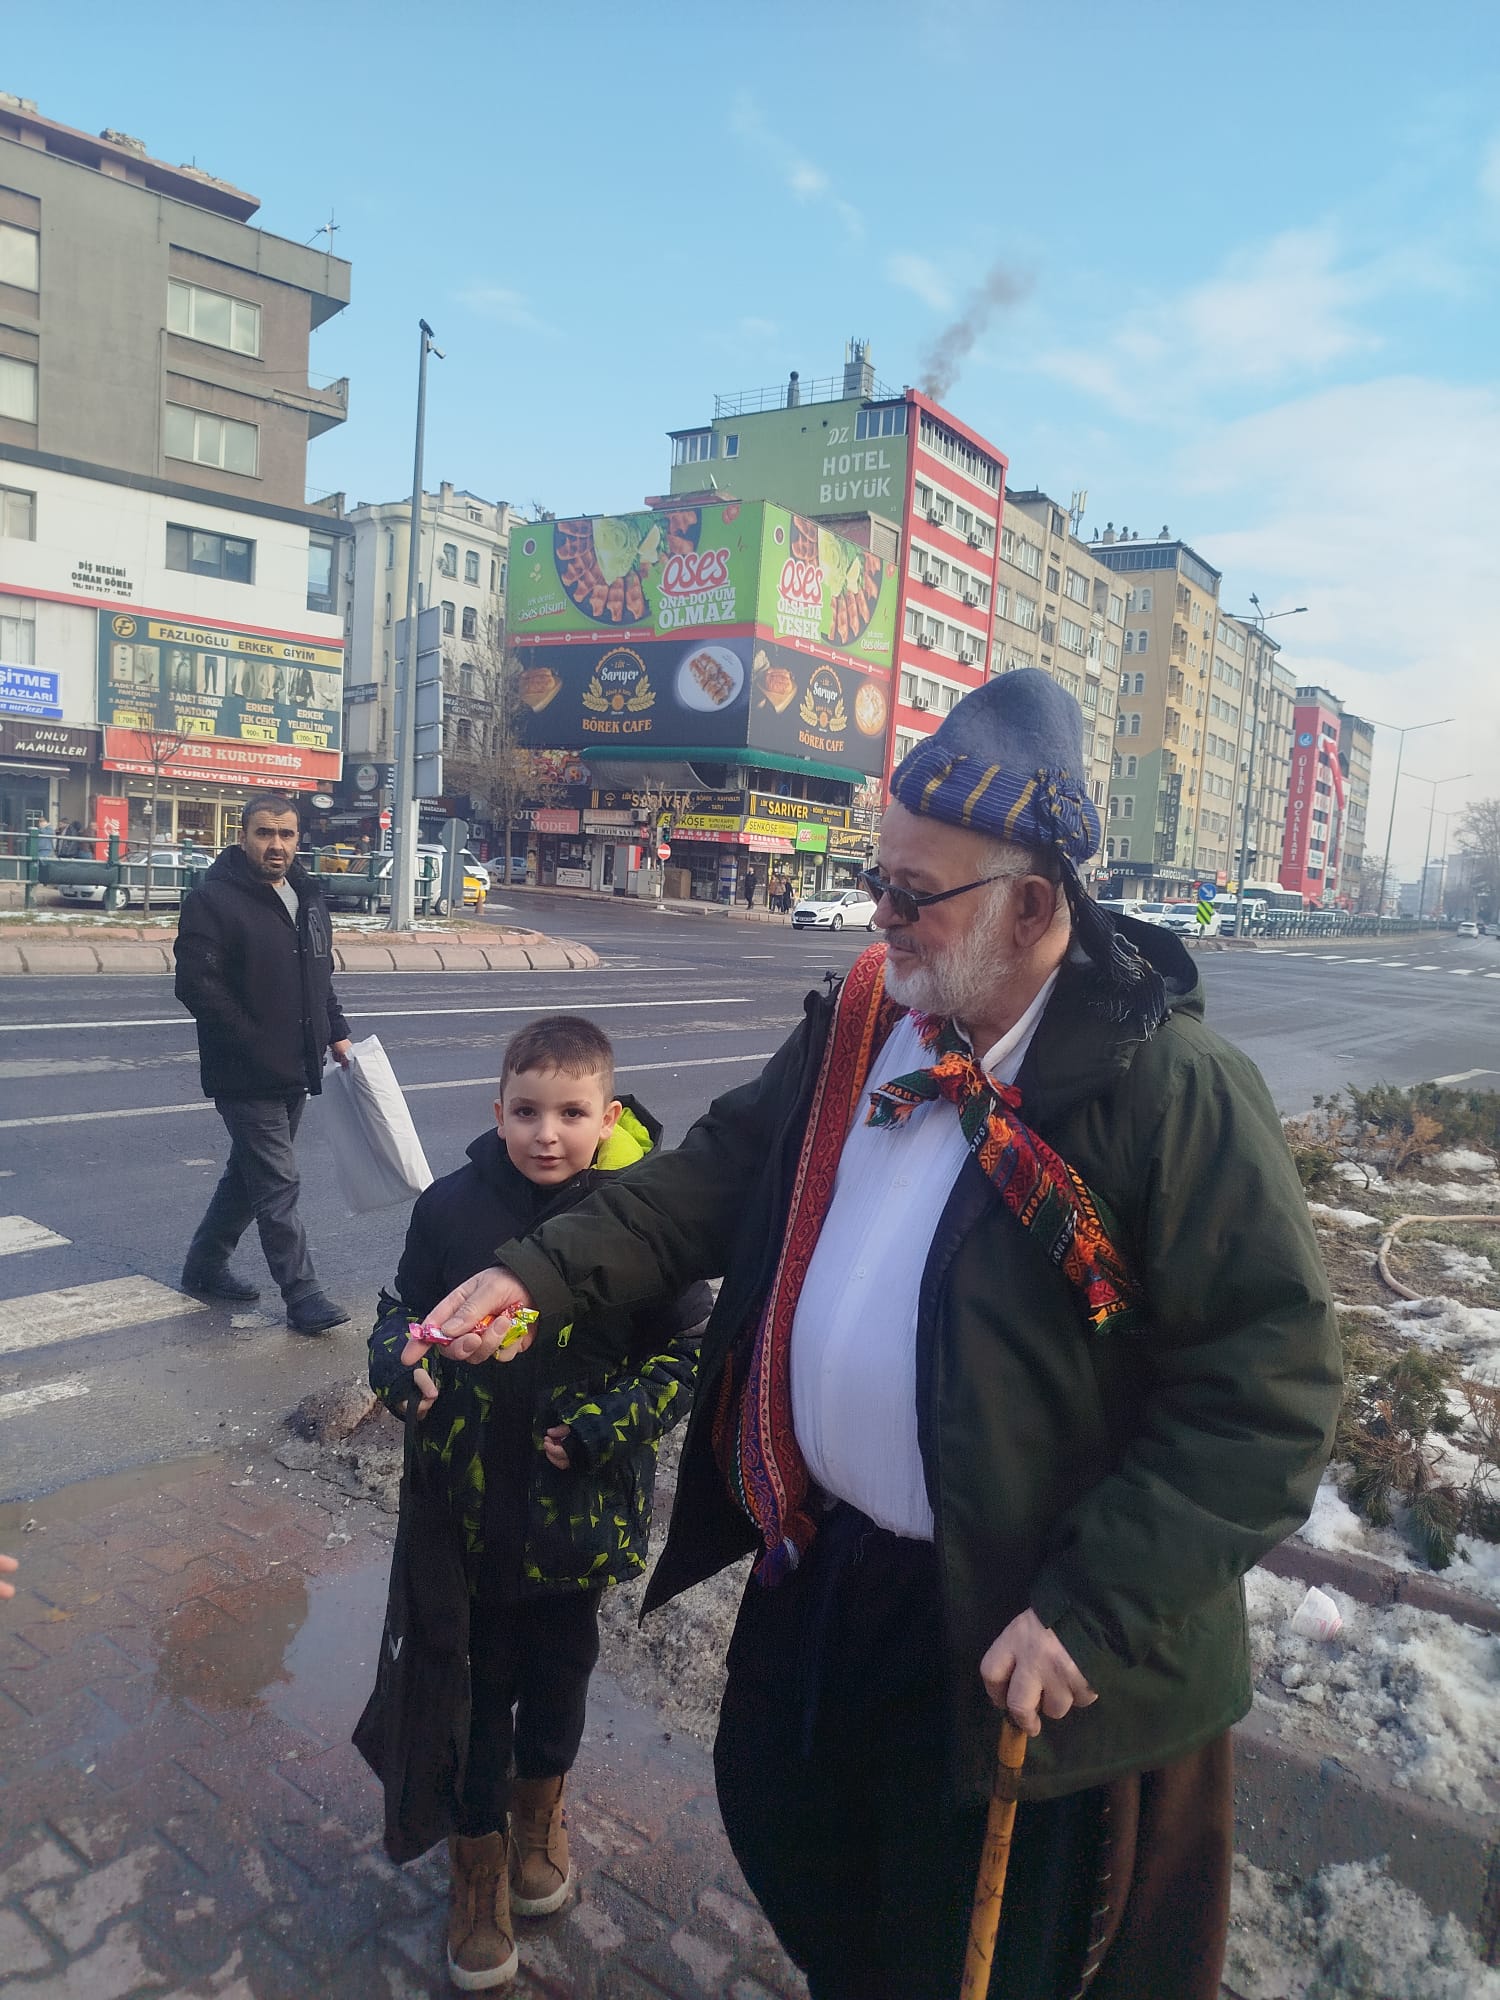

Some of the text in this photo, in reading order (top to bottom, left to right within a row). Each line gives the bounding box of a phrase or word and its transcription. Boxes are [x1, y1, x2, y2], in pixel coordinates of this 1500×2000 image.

[826, 426, 850, 446] DZ
[822, 449, 891, 476] HOTEL
[819, 477, 892, 503] BÜYÜK
[78, 560, 126, 577] DİŞ HEKİMİ
[71, 571, 133, 590] OSMAN GÖNEN
[660, 587, 736, 609] ONA DOYUM
[659, 599, 736, 628] OLMAZ
[777, 597, 822, 620] OLSA DA
[776, 612, 820, 641] YESEK
[159, 626, 230, 648] FAZLIOĞLU
[238, 640, 274, 655] ERKEK
[600, 667, 639, 685] Sarıyer
[169, 692, 223, 708] 3 ADET ERKEK
[813, 681, 838, 704] Sarıyer
[9, 703, 44, 714] merkezi
[174, 705, 218, 718] PANTOLON
[245, 702, 274, 714] ERKEK
[296, 708, 325, 721] ERKEK
[199, 720, 211, 732] TL
[238, 713, 282, 728] TEK CEKET
[287, 719, 334, 735] YELEKLİ TAKIM
[582, 716, 653, 733] BÖREK CAFE
[35, 730, 69, 742] UNLU
[262, 728, 275, 740] TL
[313, 735, 325, 746] TL
[798, 729, 845, 752] BÖREK CAFE
[15, 741, 88, 757] MAMULLERİ
[216, 748, 302, 769] KURUYEMİŞ
[115, 762, 300, 788] ÇİFTER KURUYEMİŞ KAHVE
[768, 801, 809, 819] SARIYER
[529, 821, 575, 833] MODEL
